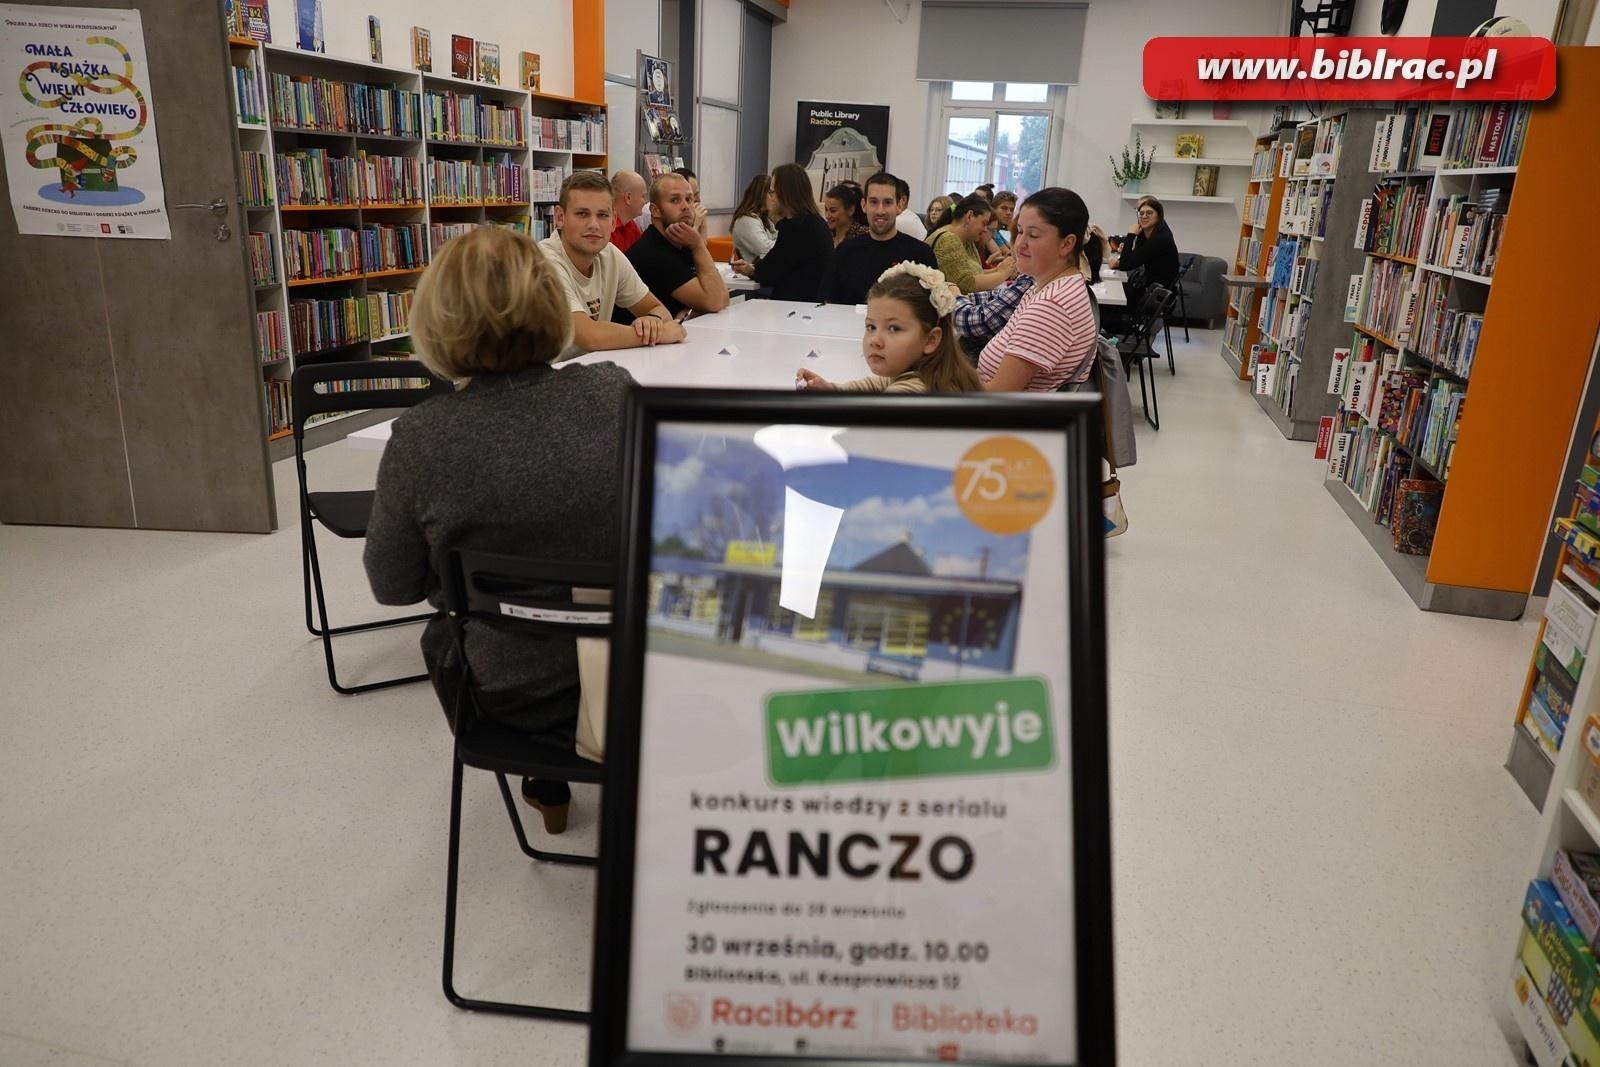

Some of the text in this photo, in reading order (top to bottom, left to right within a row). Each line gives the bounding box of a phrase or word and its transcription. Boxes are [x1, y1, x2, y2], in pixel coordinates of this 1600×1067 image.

[26, 44, 72, 57] MAŁA
[50, 61, 110, 80] KSIĄŻKA
[28, 76, 85, 99] WIELKI
[60, 101, 136, 119] CZŁOWIEK
[810, 110, 860, 120] Public Library
[1429, 118, 1446, 152] NETFLIX
[1361, 202, 1372, 230] SPORT
[1456, 226, 1470, 265] FILMY DVD
[1405, 292, 1416, 326] RYSUNEK
[1333, 364, 1343, 393] ORIGAMI
[1350, 378, 1362, 410] HOBBY
[957, 457, 1008, 503] 75
[1337, 455, 1346, 478] ZABAWY
[775, 701, 1044, 760] Wilkowyje
[690, 791, 1006, 821] konkurs wiedzy z serialu
[693, 828, 975, 883] RANCZO
[686, 933, 990, 966] 30 września, godz. 10.00
[684, 966, 781, 987] Biblioteka,
[789, 967, 811, 987] ul.
[942, 972, 961, 991] 12
[710, 997, 1040, 1037] Racibórz Biblioteka
